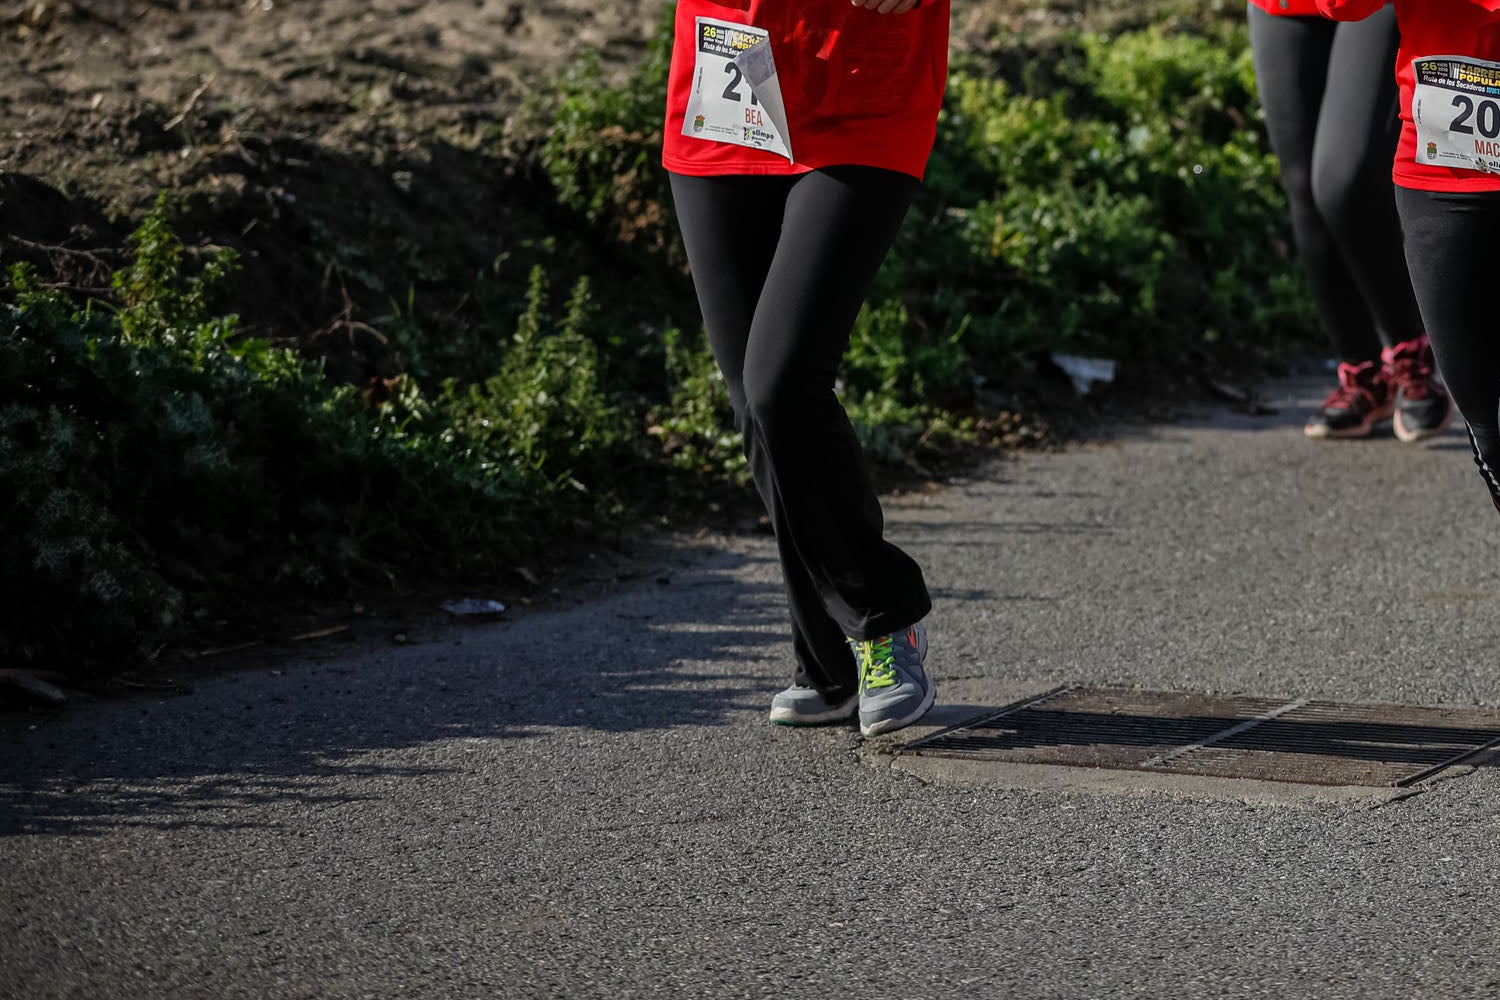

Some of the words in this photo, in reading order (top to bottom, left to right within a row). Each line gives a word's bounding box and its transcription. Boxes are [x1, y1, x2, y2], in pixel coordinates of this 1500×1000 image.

[703, 26, 717, 38] 26
[703, 41, 715, 51] Ruta
[715, 44, 722, 52] de
[1421, 62, 1437, 71] 26
[1423, 75, 1438, 83] Ruta
[1446, 78, 1456, 87] los
[1456, 80, 1486, 93] Secaderos
[745, 108, 763, 126] BEA
[752, 129, 775, 140] olimpo
